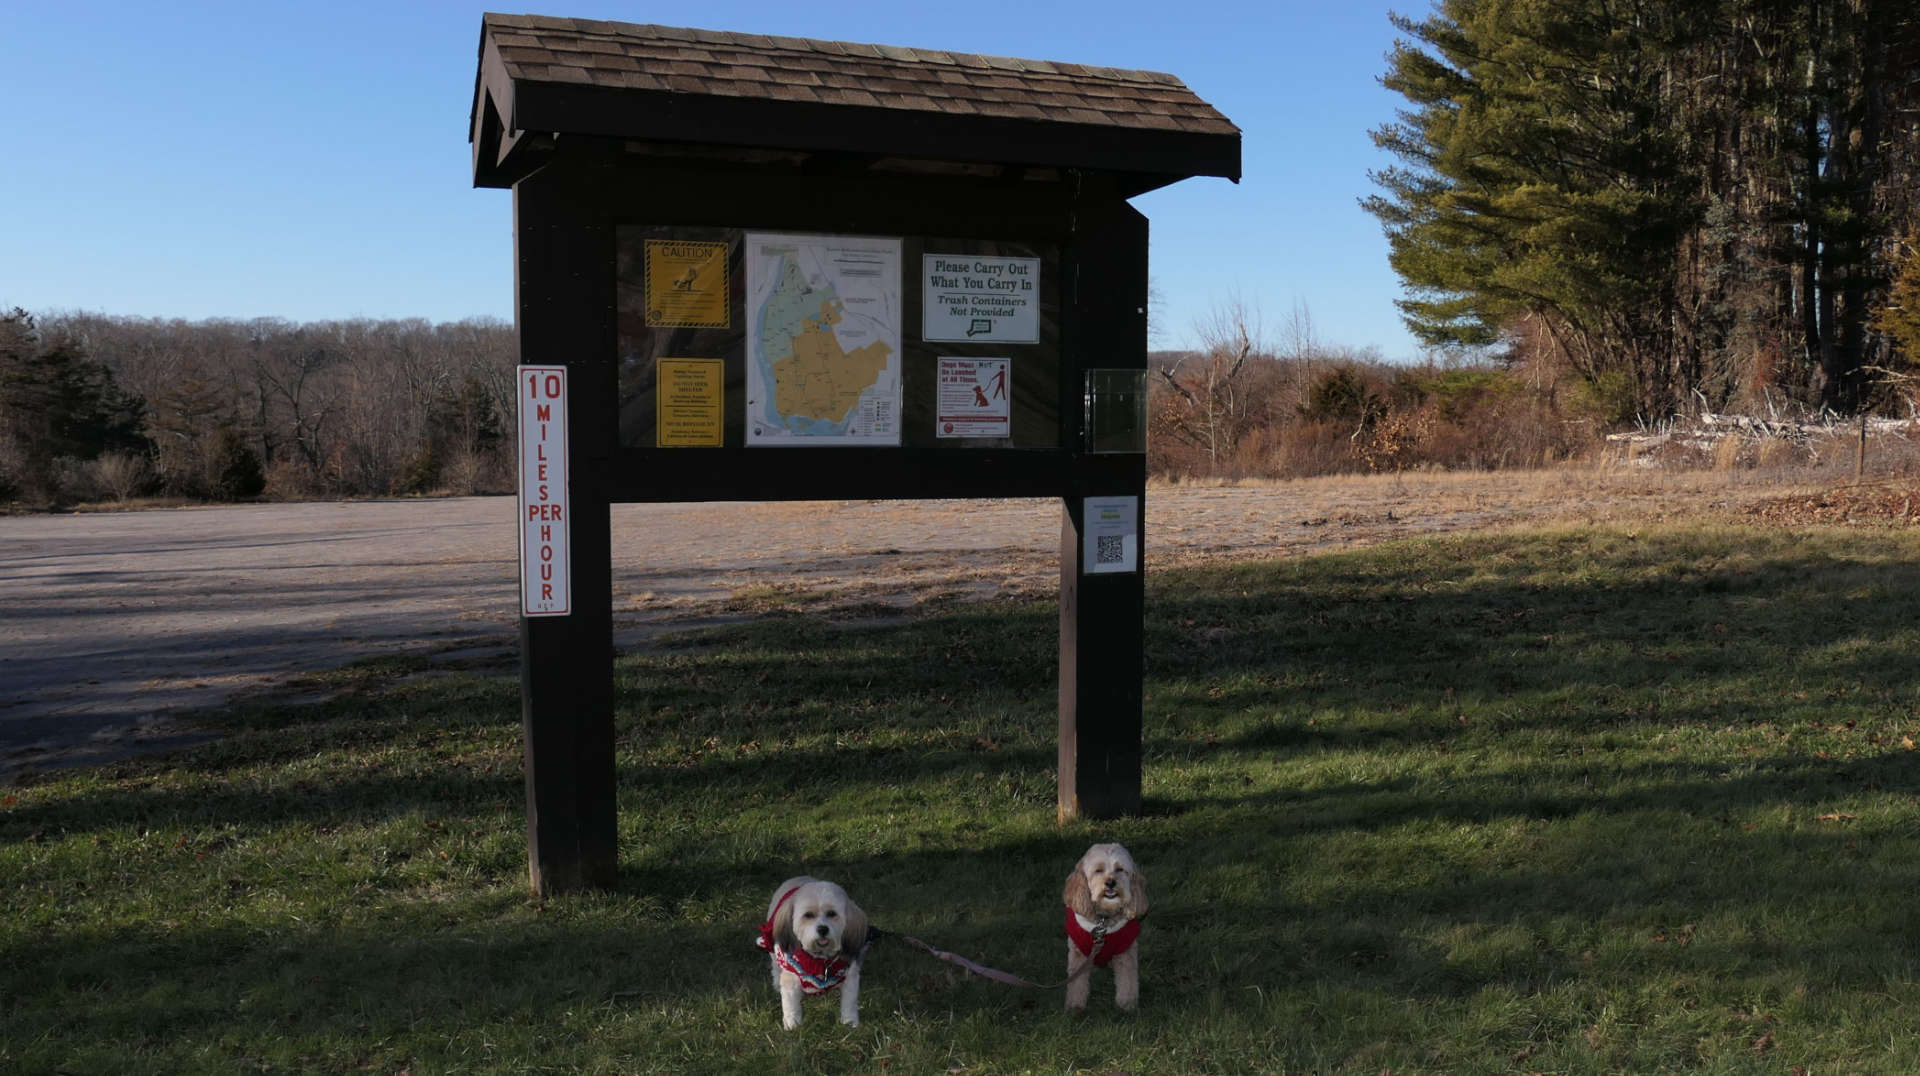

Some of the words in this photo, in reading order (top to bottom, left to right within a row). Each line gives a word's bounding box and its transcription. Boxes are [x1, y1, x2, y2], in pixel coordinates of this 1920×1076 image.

[662, 247, 712, 257] CAUTION
[935, 260, 969, 273] Please
[974, 262, 1004, 276] Carry
[1008, 263, 1028, 275] Out
[931, 276, 959, 288] What
[963, 277, 983, 288] You
[987, 278, 1017, 293] Carry
[1021, 279, 1032, 290] In
[938, 295, 968, 305] Trash
[972, 296, 1027, 306] Containers
[950, 307, 967, 316] Not
[970, 307, 1015, 317] Provided
[529, 375, 560, 399] 10
[537, 404, 550, 501] MILES
[528, 505, 561, 521] PER
[541, 525, 552, 601] HOUR
